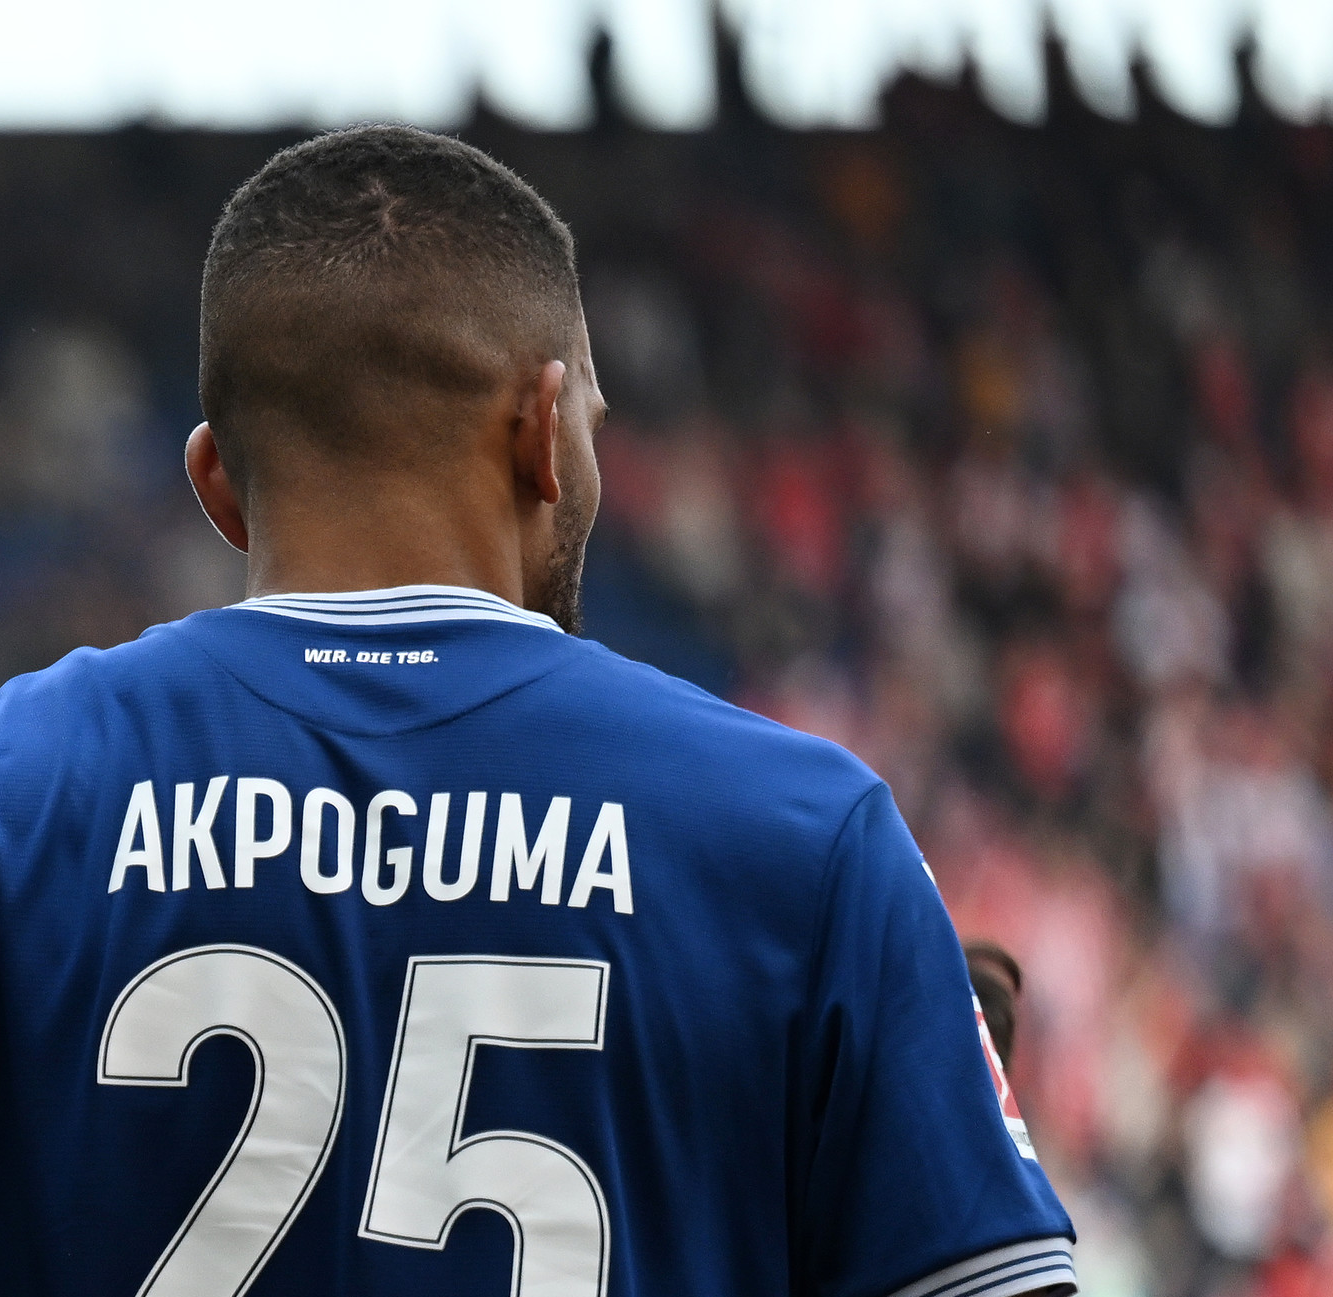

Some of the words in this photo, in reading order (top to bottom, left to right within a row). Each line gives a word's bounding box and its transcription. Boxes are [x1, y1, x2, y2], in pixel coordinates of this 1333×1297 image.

[304, 649, 351, 664] WIR.
[355, 651, 393, 664] DIE
[396, 650, 439, 664] TSG.
[107, 775, 634, 915] AKPOGUMA
